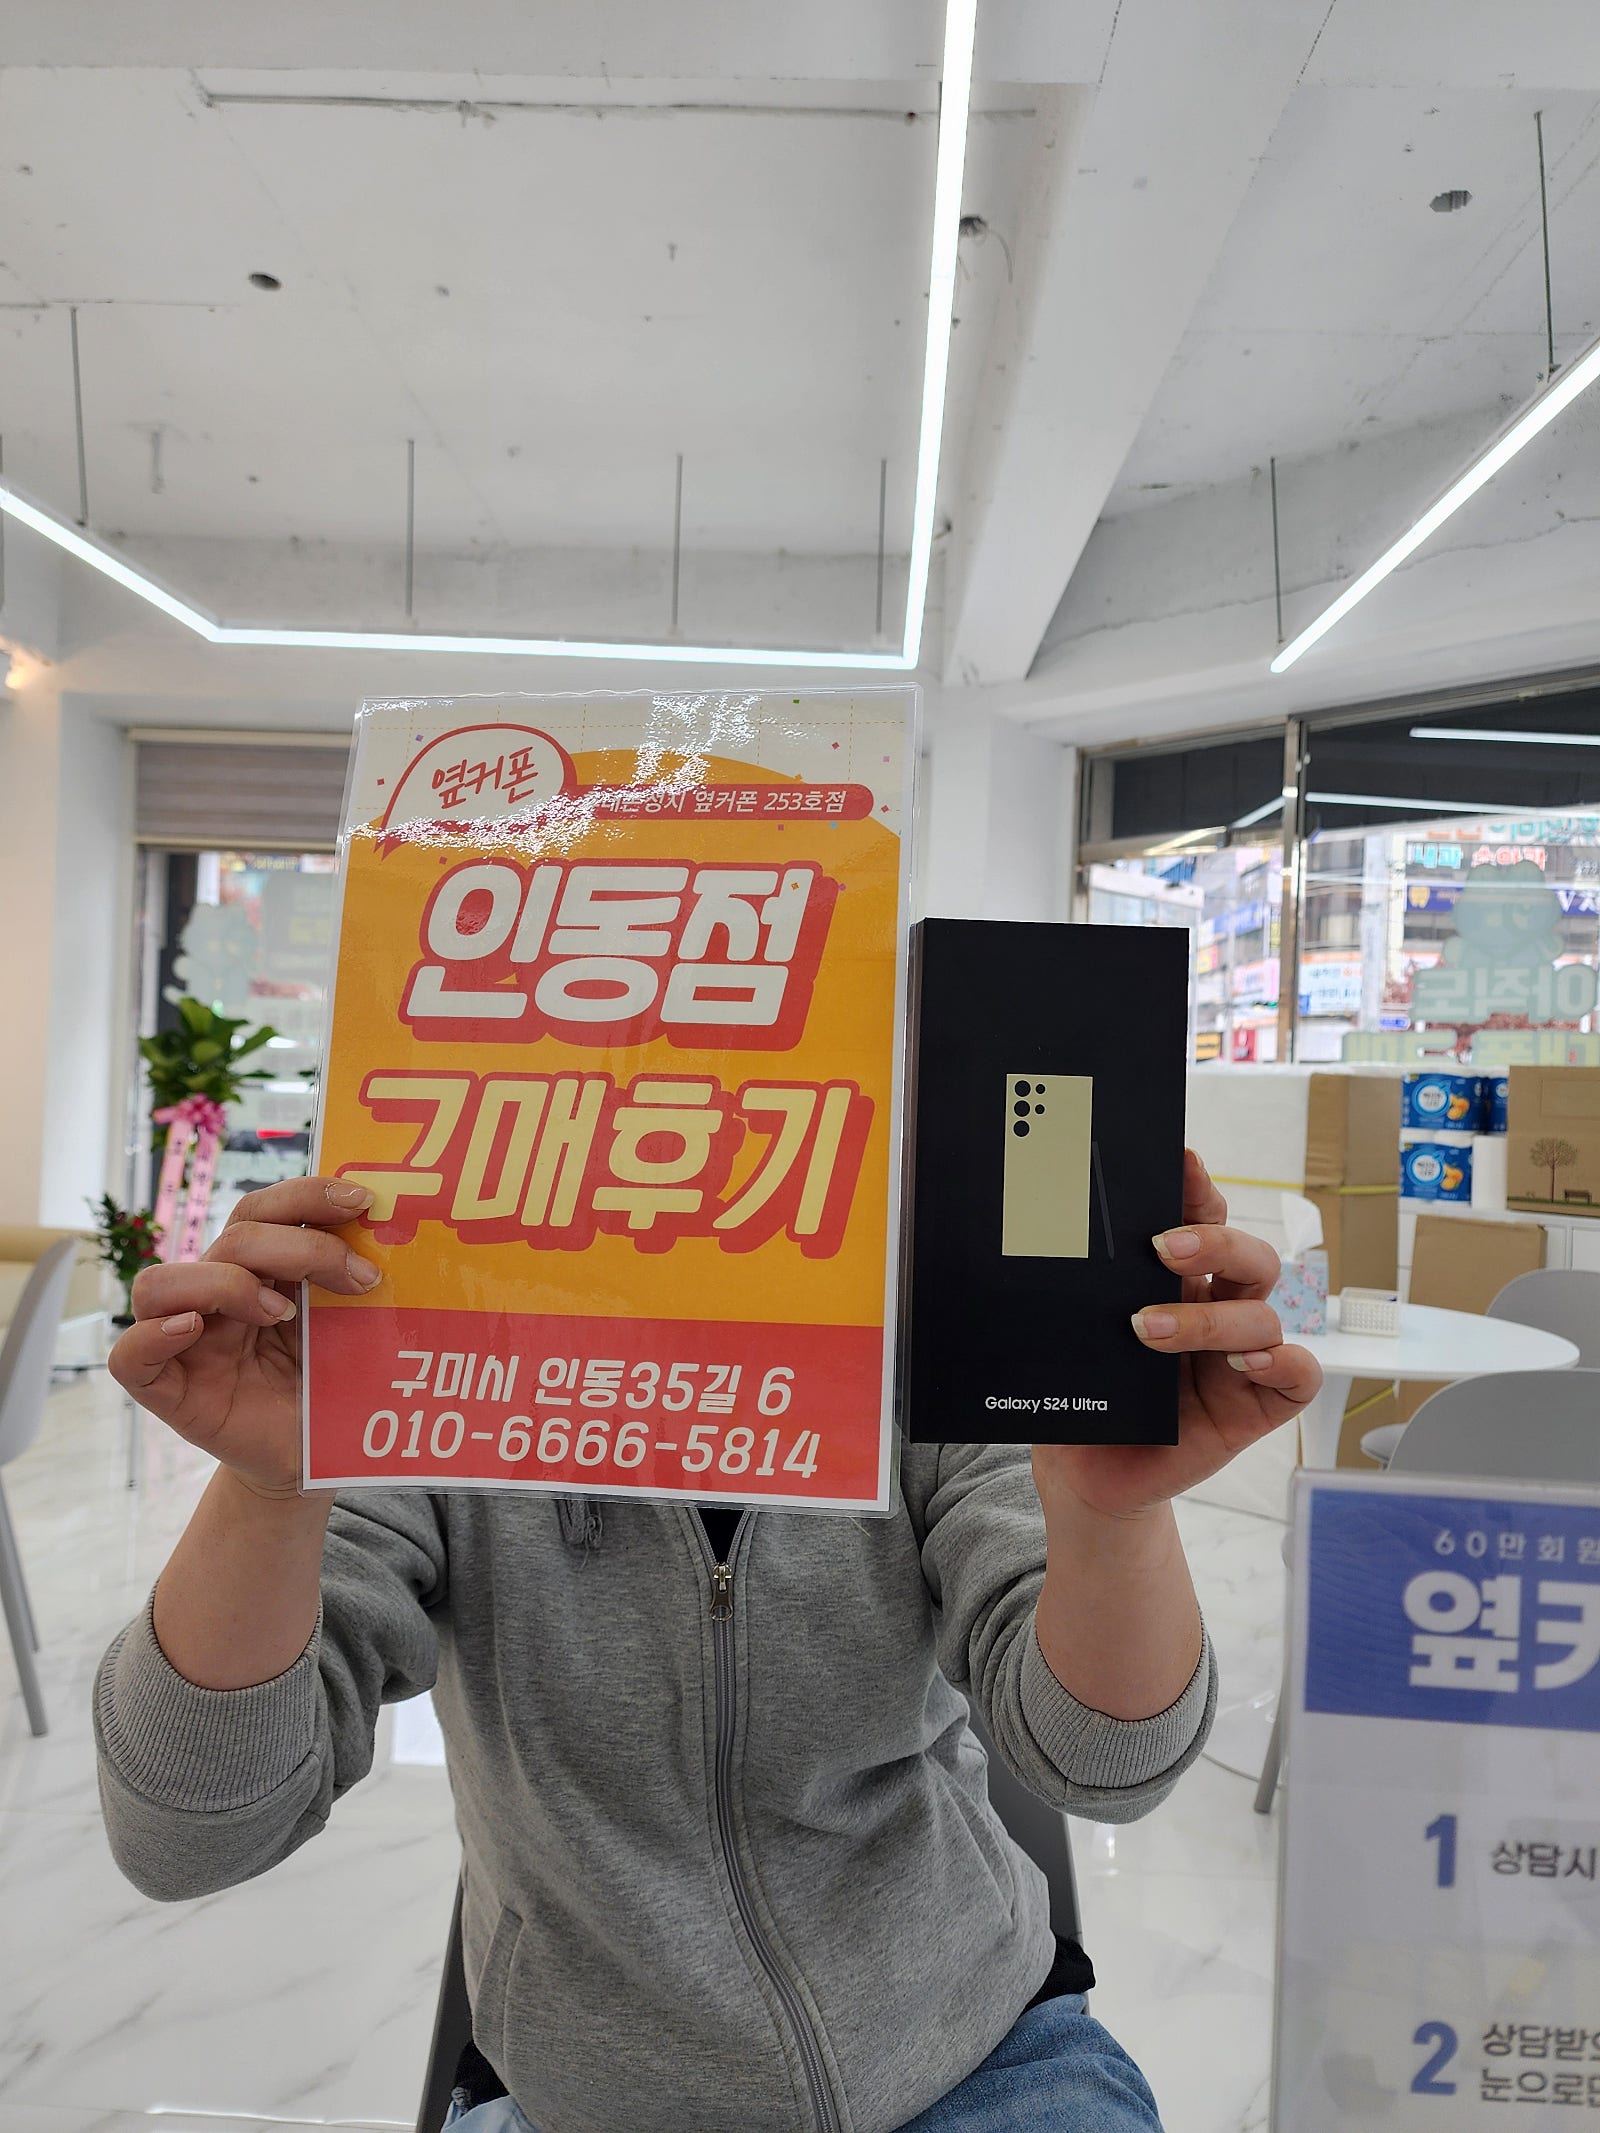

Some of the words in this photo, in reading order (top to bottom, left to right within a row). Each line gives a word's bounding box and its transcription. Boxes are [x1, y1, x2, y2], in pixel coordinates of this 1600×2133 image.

[694, 790, 758, 813] 옆커폰
[763, 791, 847, 813] 253호점
[405, 864, 815, 1027] 인동점
[342, 1076, 852, 1236] 구매후기
[390, 1350, 520, 1403] 구미시
[534, 1357, 743, 1415] 인동35길
[756, 1366, 795, 1417] 6
[985, 1396, 1041, 1413] Galaxy
[1043, 1397, 1069, 1411] S24
[1072, 1397, 1108, 1411] Ultra
[361, 1409, 821, 1480] 010-6666-5814
[1425, 1813, 1457, 1888] 1
[1492, 1840, 1598, 1880] 상담시
[1410, 2021, 1458, 2095] 2
